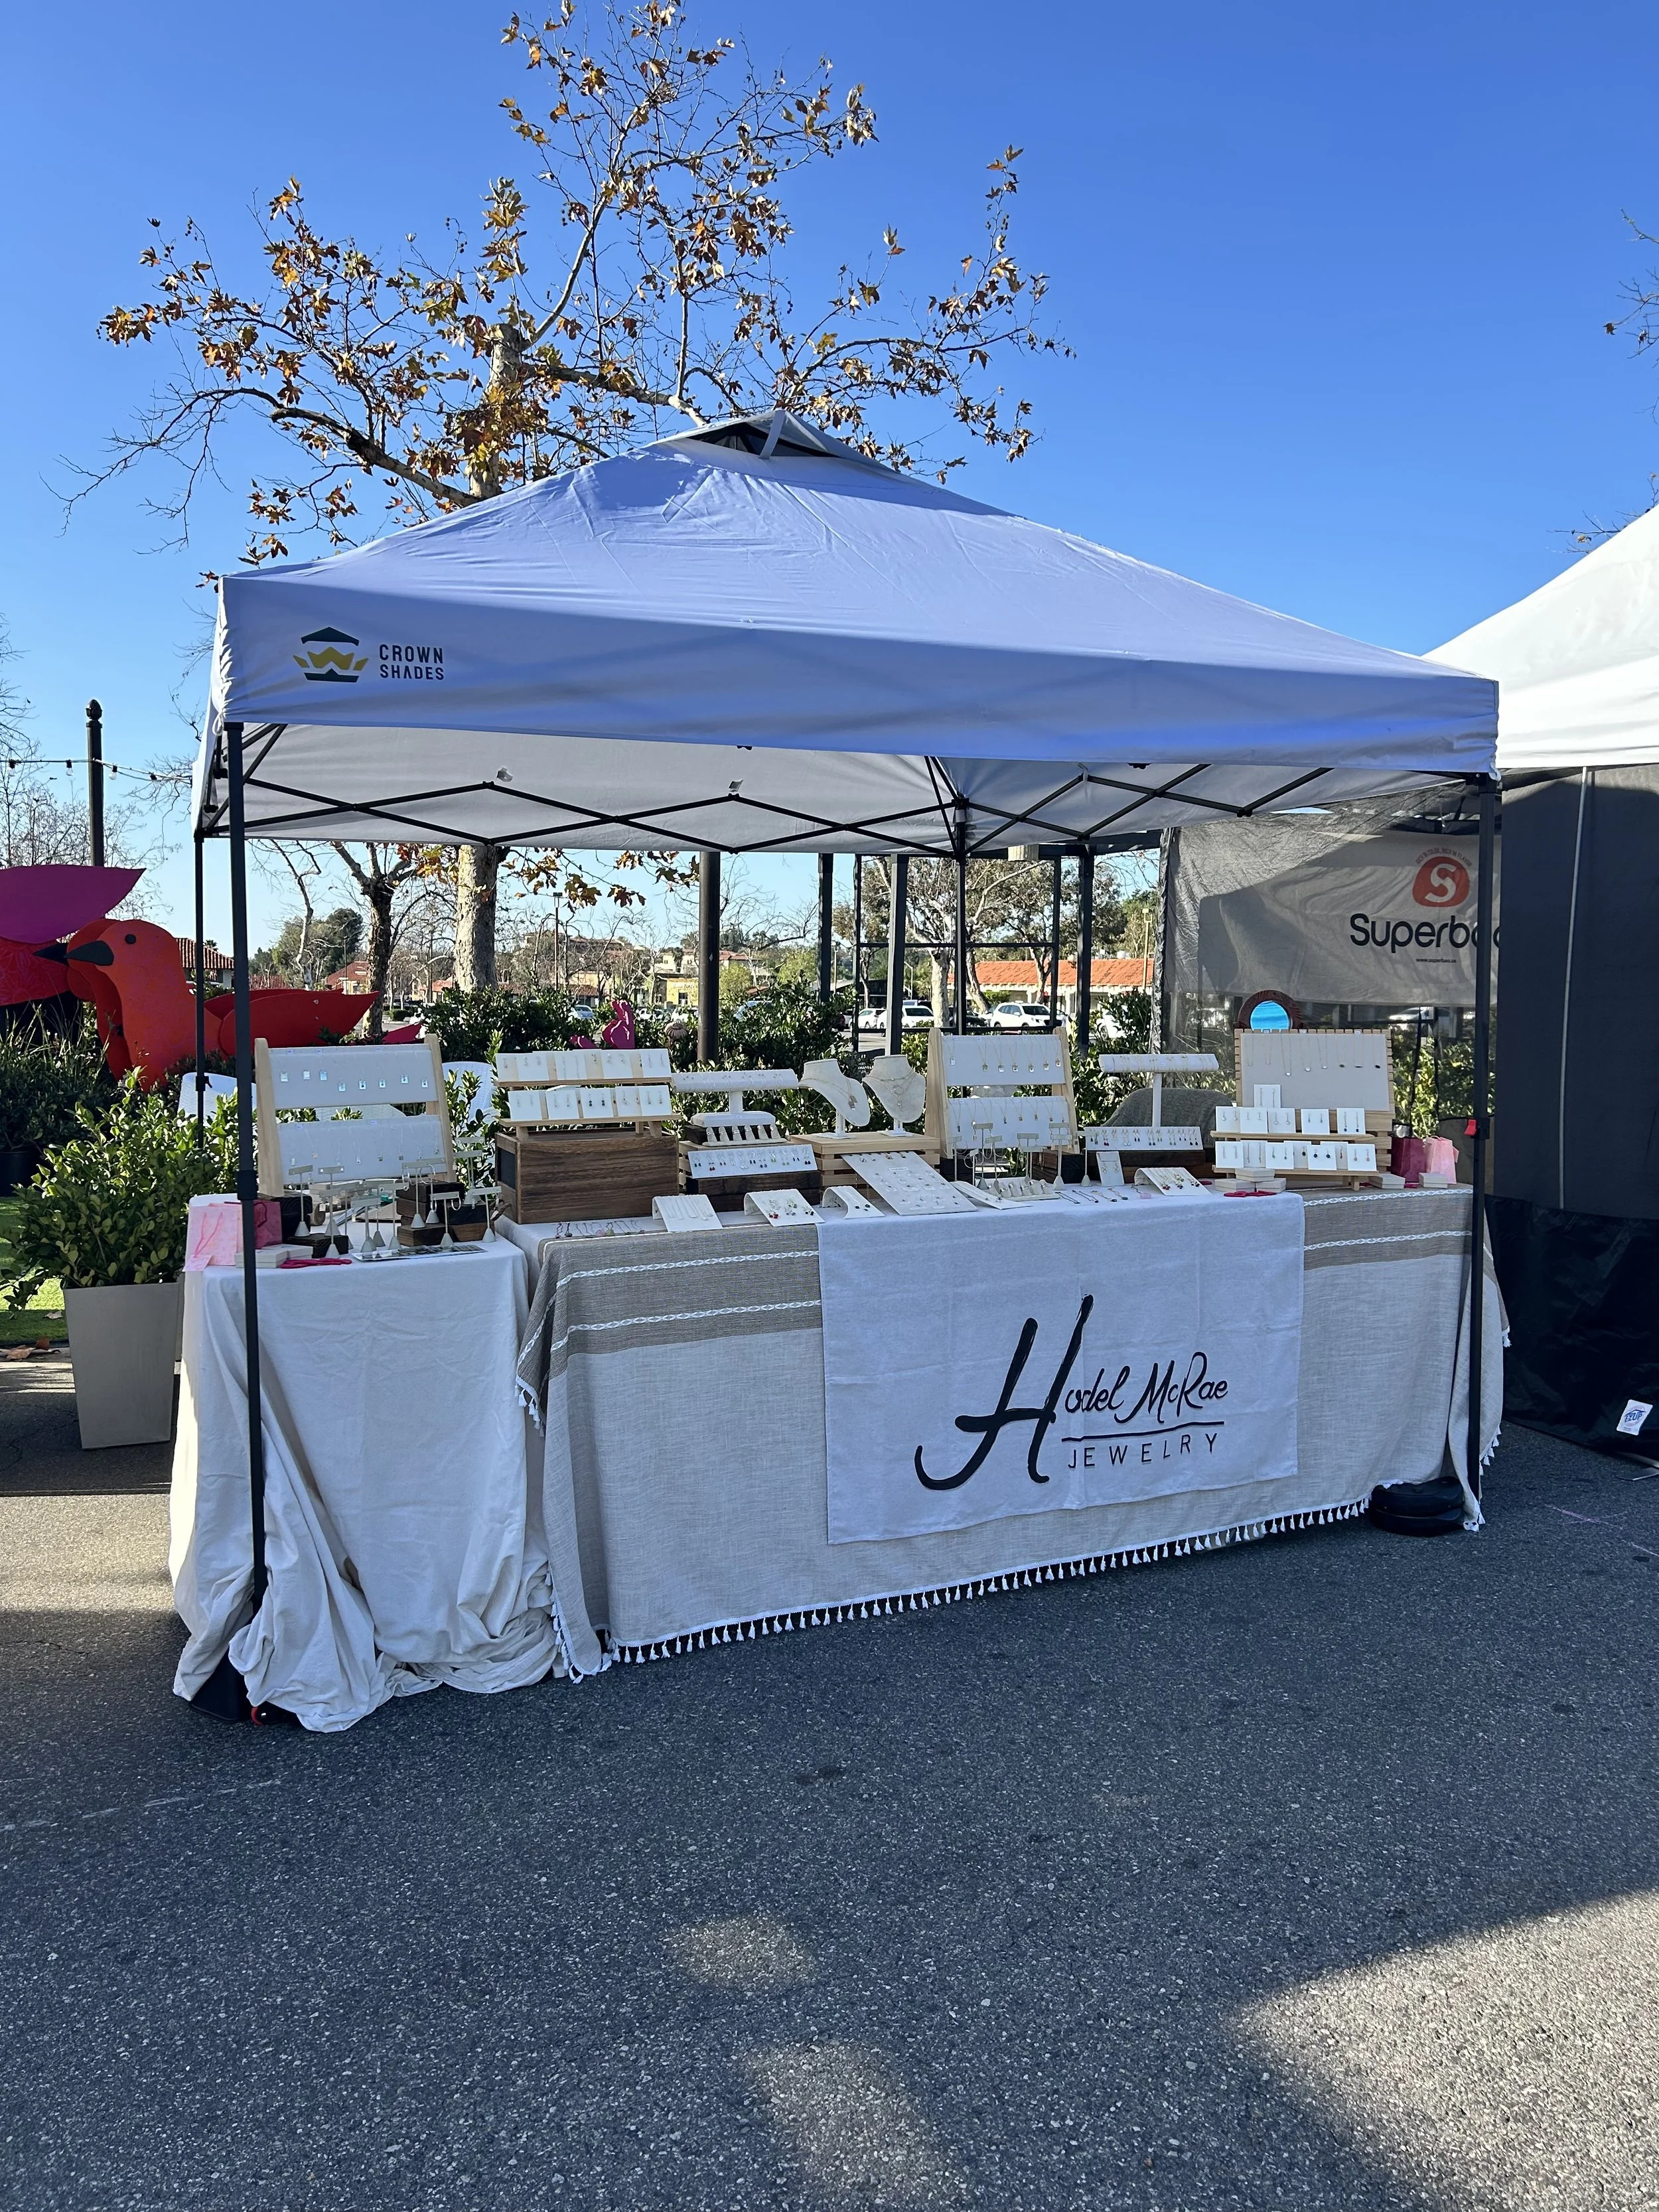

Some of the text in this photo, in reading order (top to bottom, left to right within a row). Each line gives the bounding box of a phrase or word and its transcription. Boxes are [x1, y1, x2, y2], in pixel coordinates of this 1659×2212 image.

[379, 644, 444, 664] CROWN
[380, 664, 445, 680] SHADES
[1350, 913, 1500, 954] Superb
[914, 1293, 1229, 1491] Hodel McRae
[1067, 1433, 1218, 1469] JEWELRY
